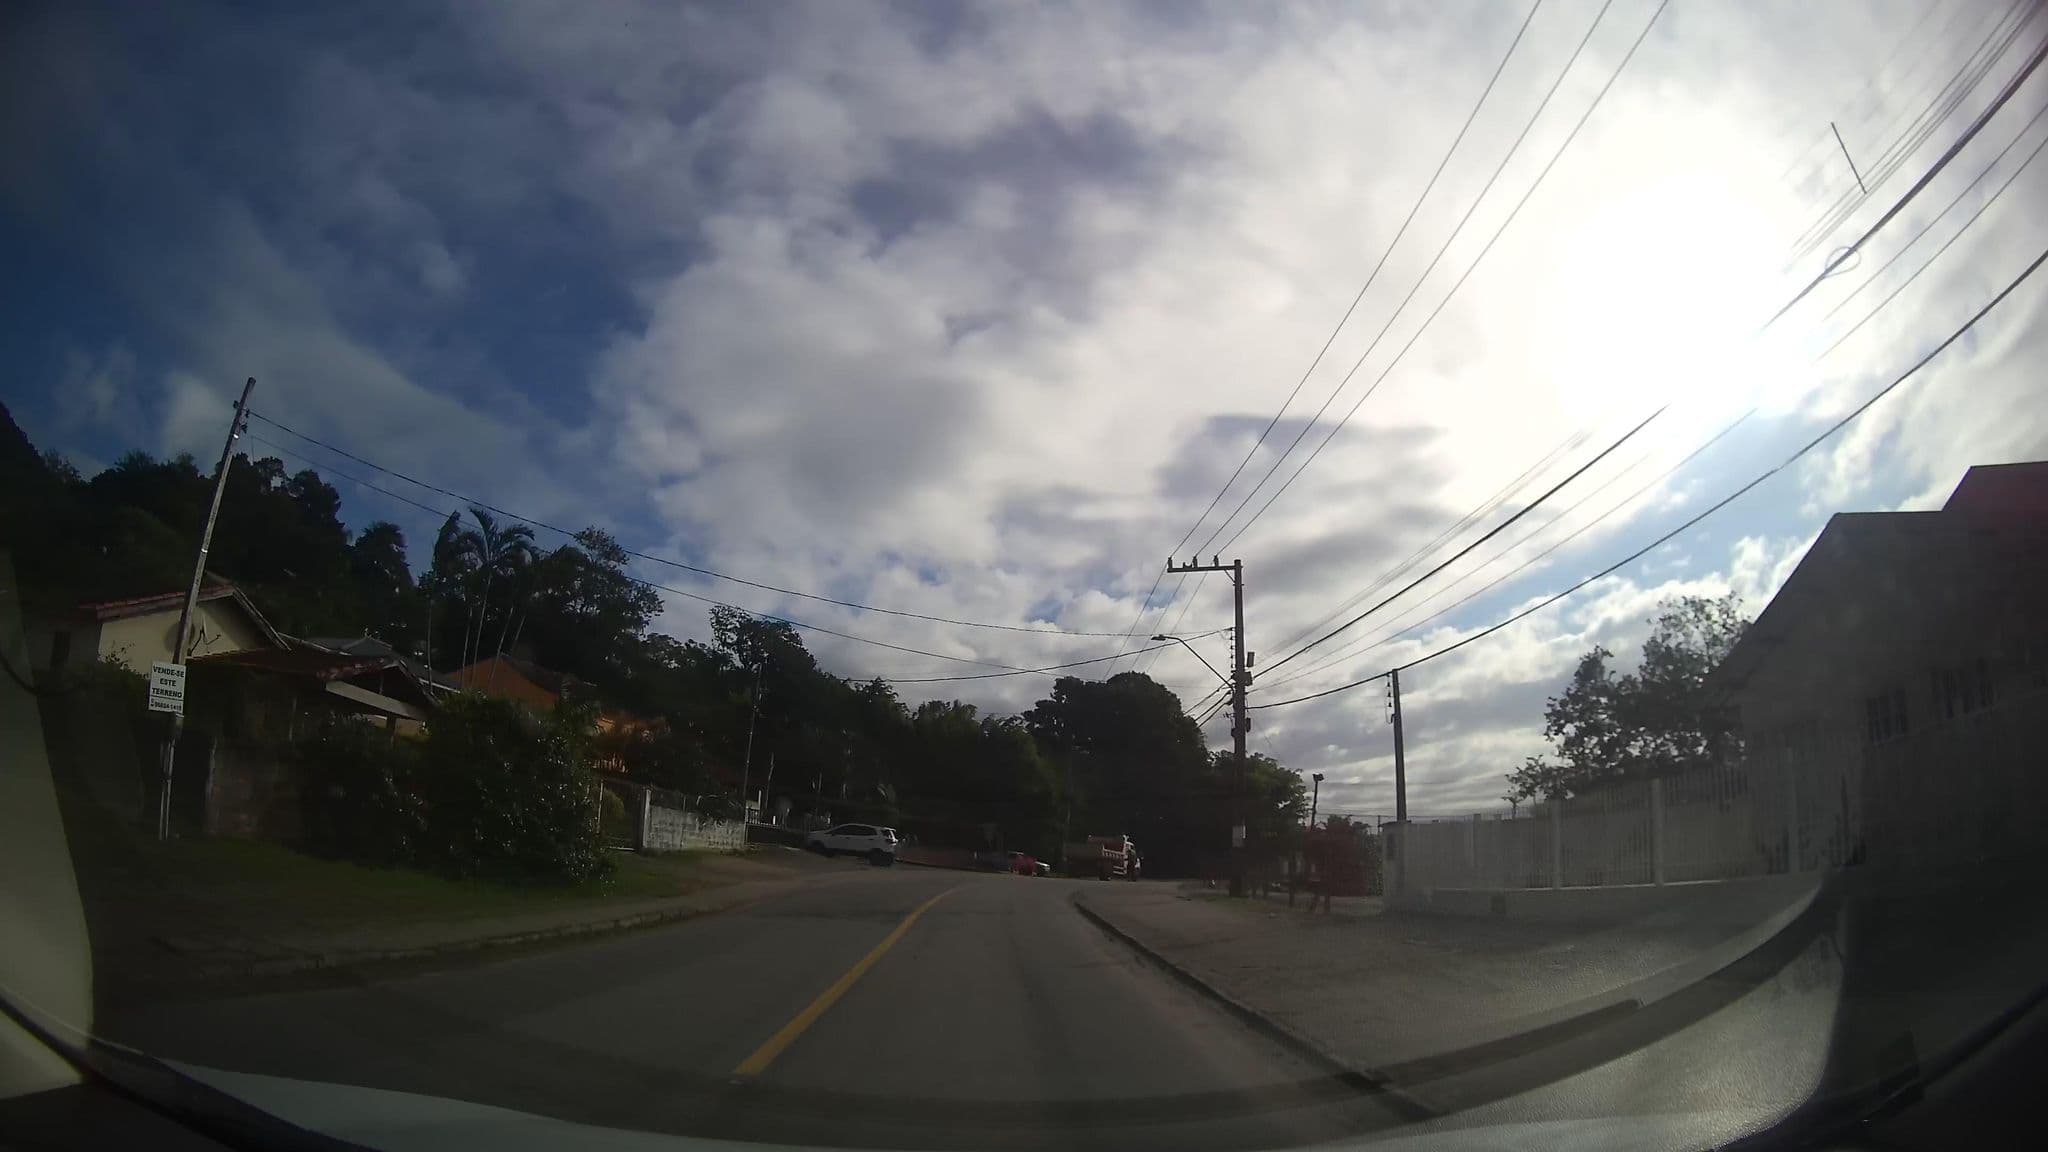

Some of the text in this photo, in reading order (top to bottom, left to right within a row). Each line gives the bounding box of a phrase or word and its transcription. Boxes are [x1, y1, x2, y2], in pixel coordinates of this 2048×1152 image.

[153, 666, 184, 678] VENDE-SE
[160, 678, 176, 687] ESTE
[152, 688, 182, 698] TERRENO
